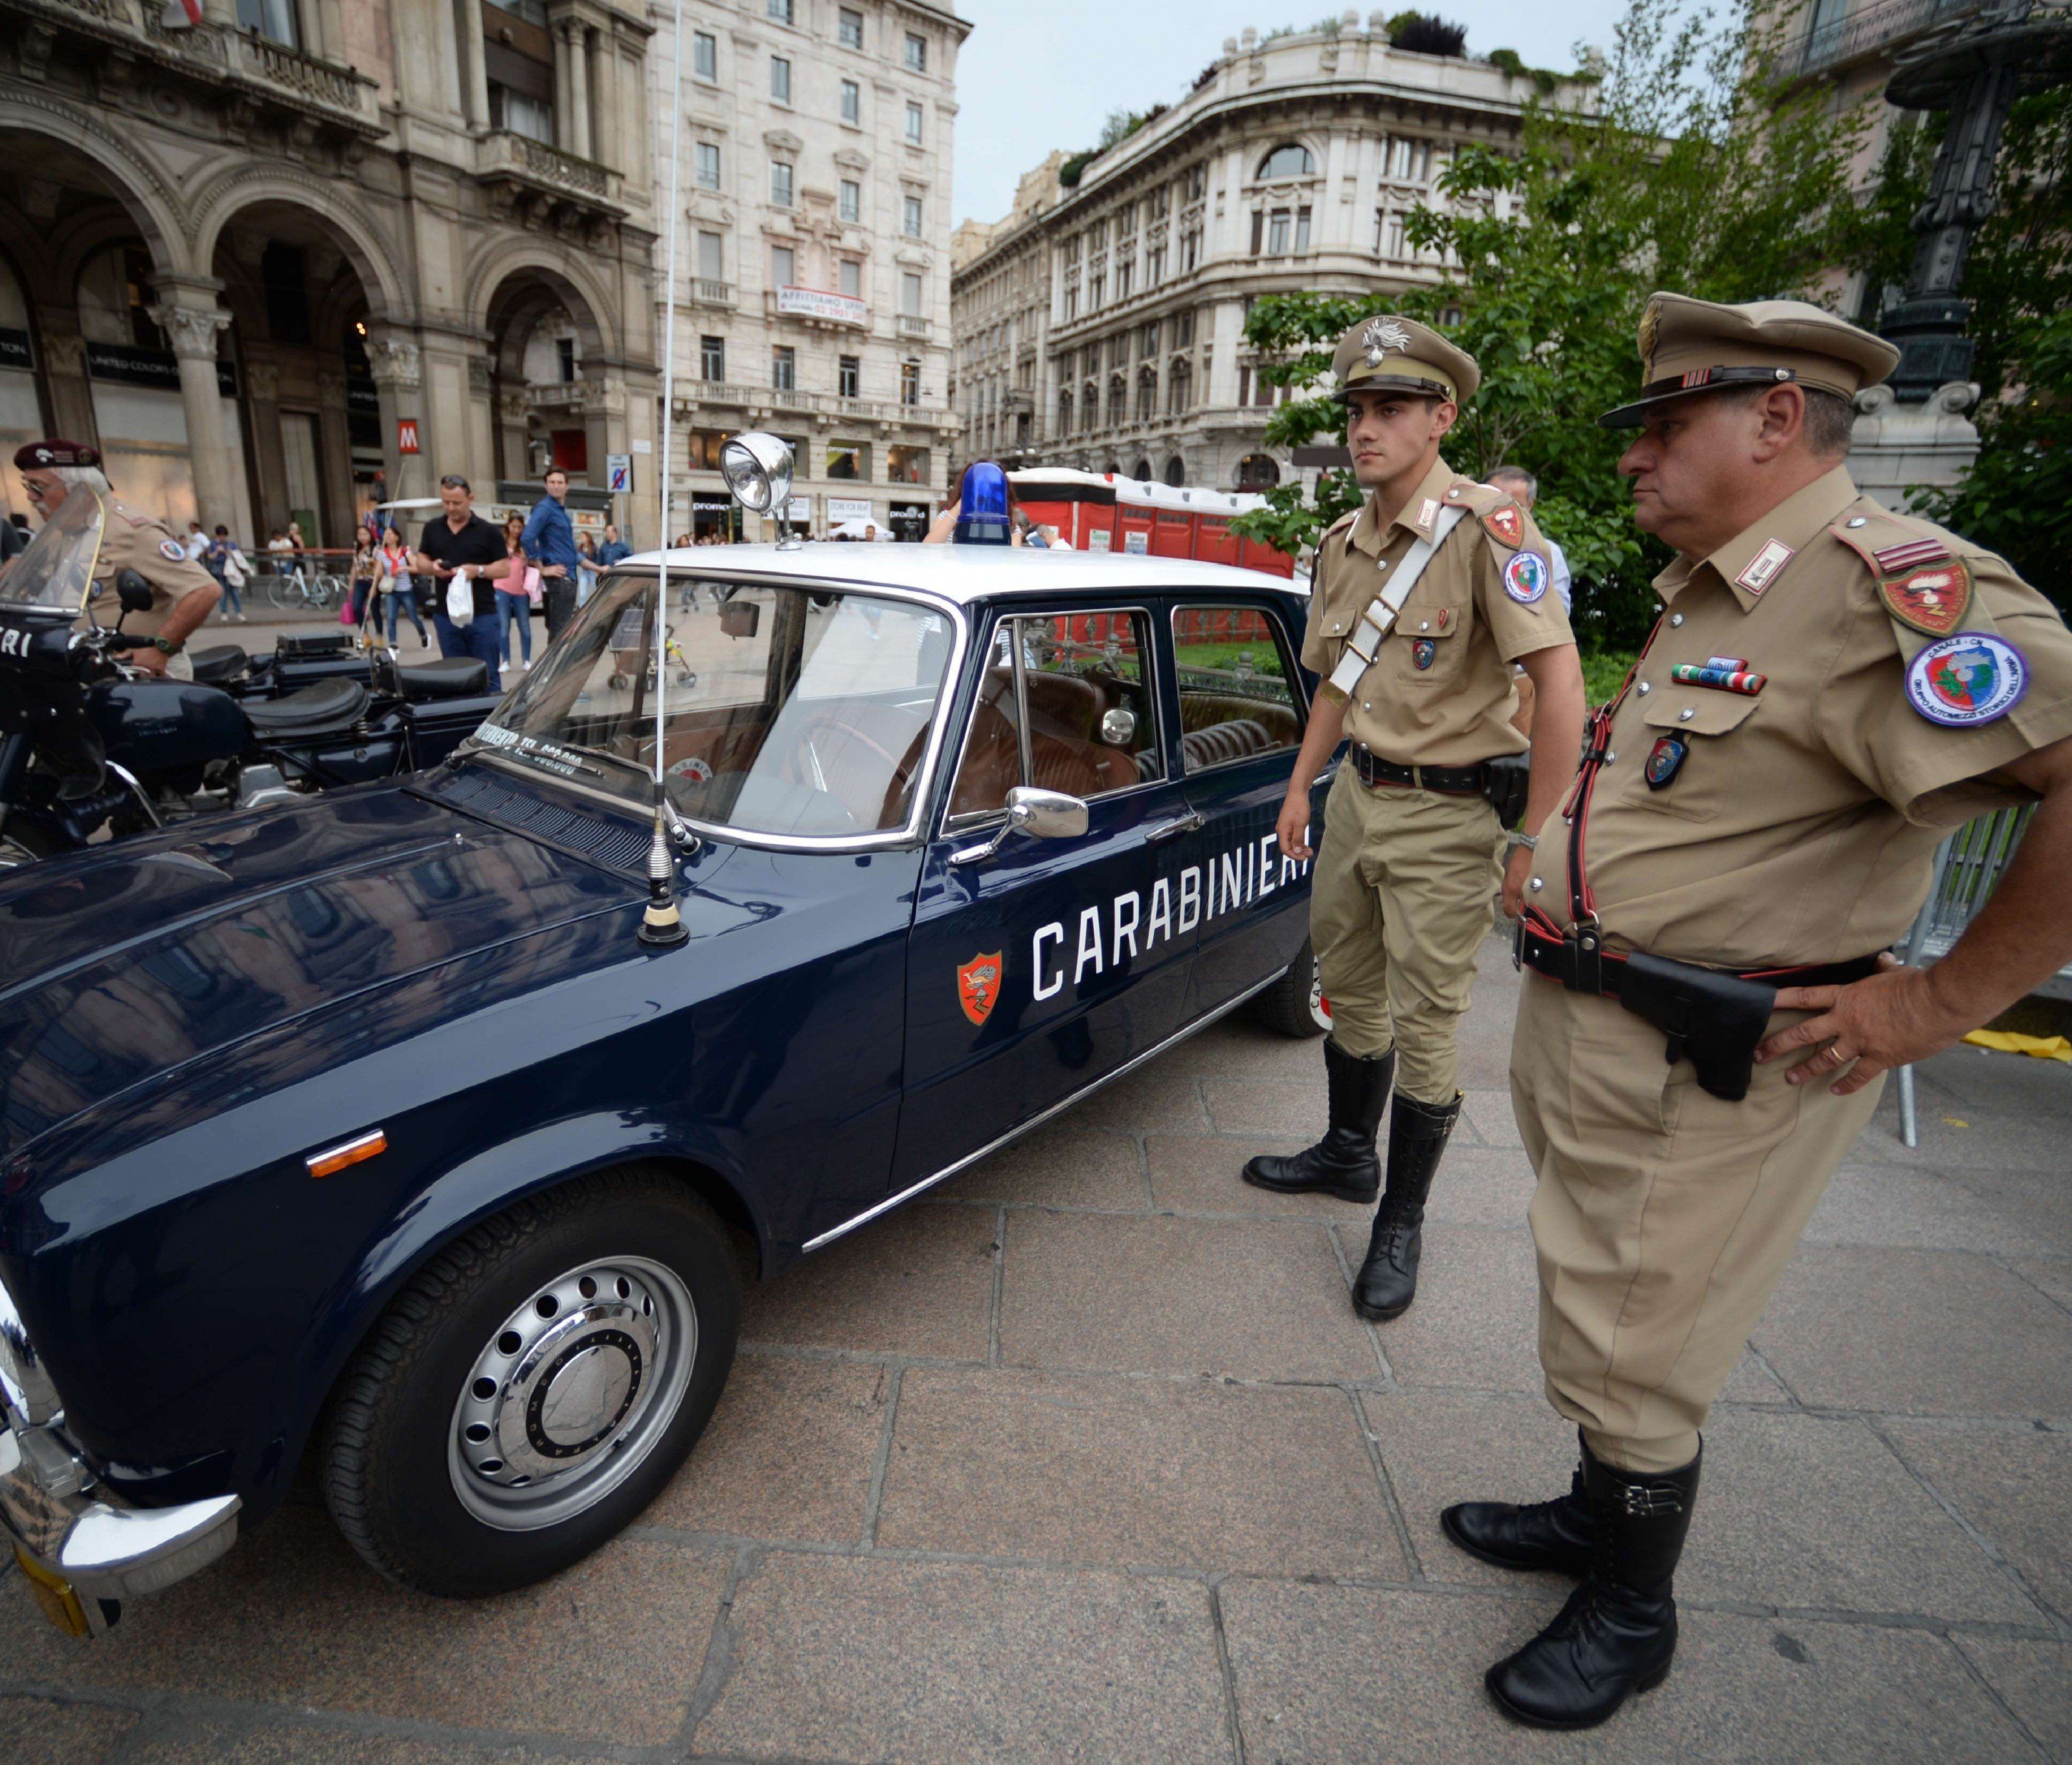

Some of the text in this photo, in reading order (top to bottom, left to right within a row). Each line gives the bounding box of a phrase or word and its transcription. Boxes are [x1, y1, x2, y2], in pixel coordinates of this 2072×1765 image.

[400, 426, 418, 448] M
[693, 502, 731, 512] promo
[0, 626, 32, 658] RI
[1928, 638, 1962, 658] CANALE
[1914, 679, 1930, 706] GRUPPO
[1928, 704, 1977, 719] AUTOMEZZI
[1978, 695, 2011, 716] STORICI
